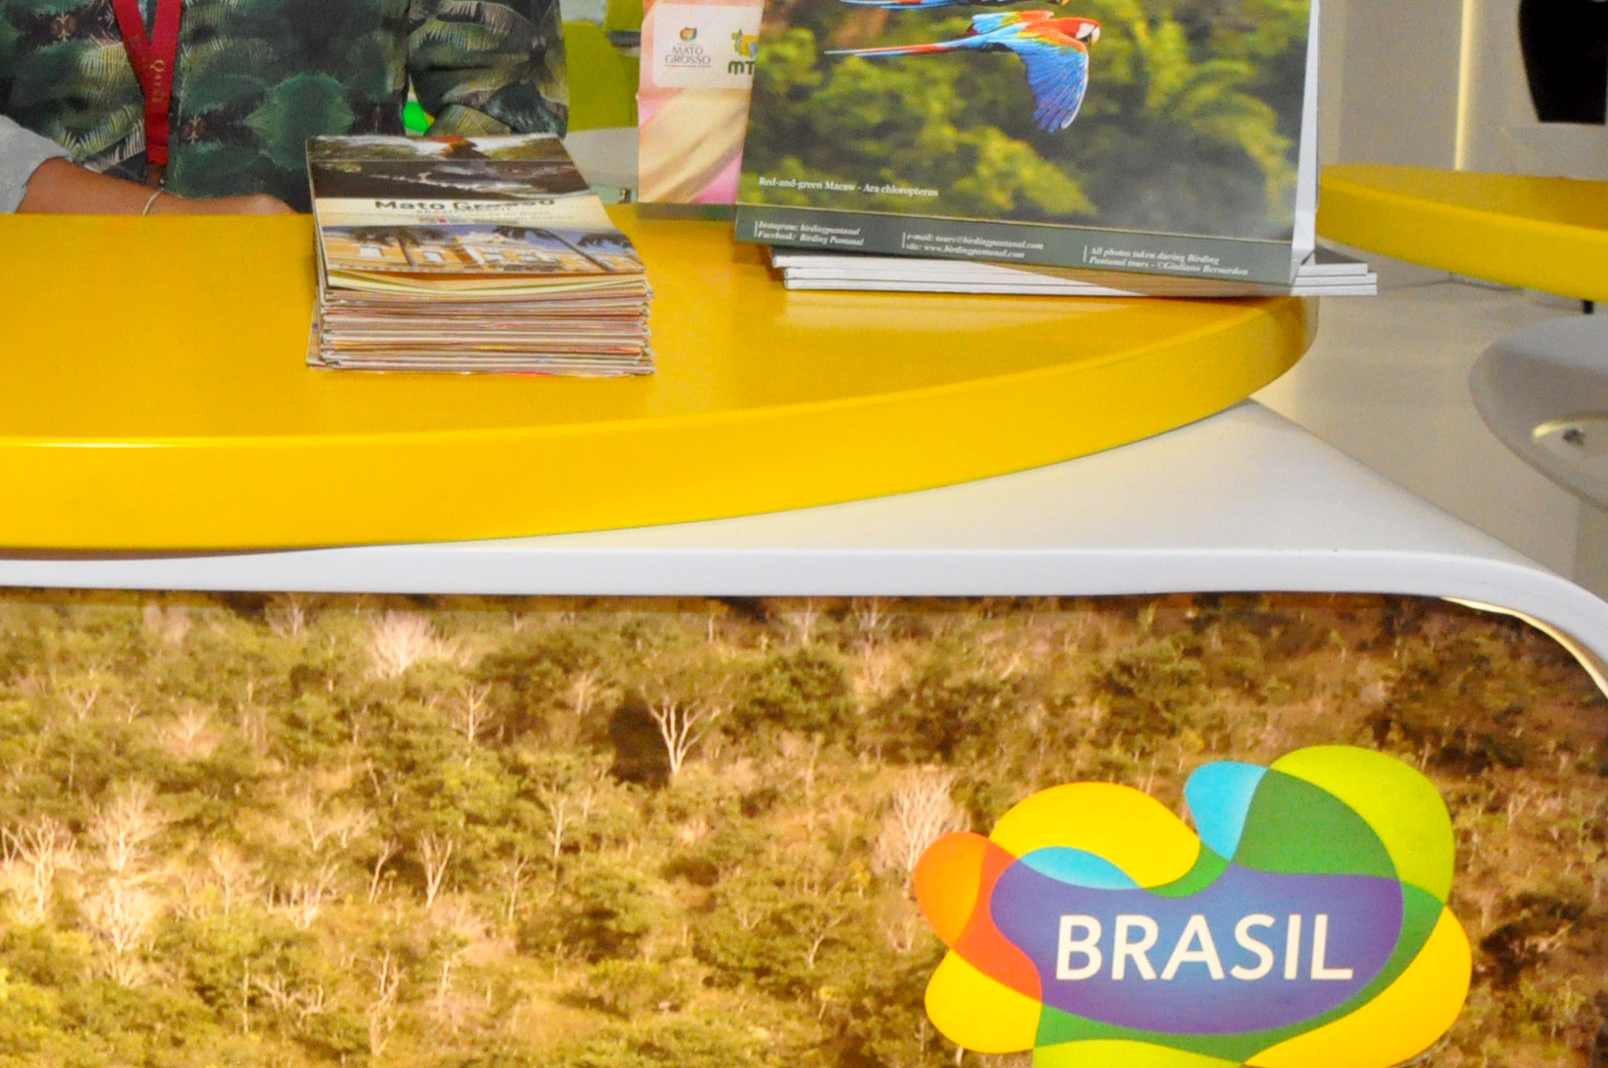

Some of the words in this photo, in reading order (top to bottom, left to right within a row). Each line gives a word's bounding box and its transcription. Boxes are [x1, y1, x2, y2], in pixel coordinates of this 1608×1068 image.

[673, 46, 704, 56] MATO
[664, 54, 712, 65] GROSSO
[758, 176, 823, 190] Red-and-green
[824, 180, 856, 192] Macaw
[862, 183, 880, 194] Ara
[881, 185, 939, 198] chloropterus
[375, 200, 445, 210] Mato
[799, 233, 828, 245] Birding
[829, 235, 864, 246] Pantanal
[1091, 246, 1102, 256] All
[1103, 247, 1131, 259] photos
[1132, 250, 1156, 259] taken
[1157, 251, 1185, 263] during
[1187, 253, 1221, 265] Birding
[1089, 256, 1127, 266] Pantanal
[1127, 259, 1150, 268] tours
[1055, 914, 1353, 981] BRASIL
